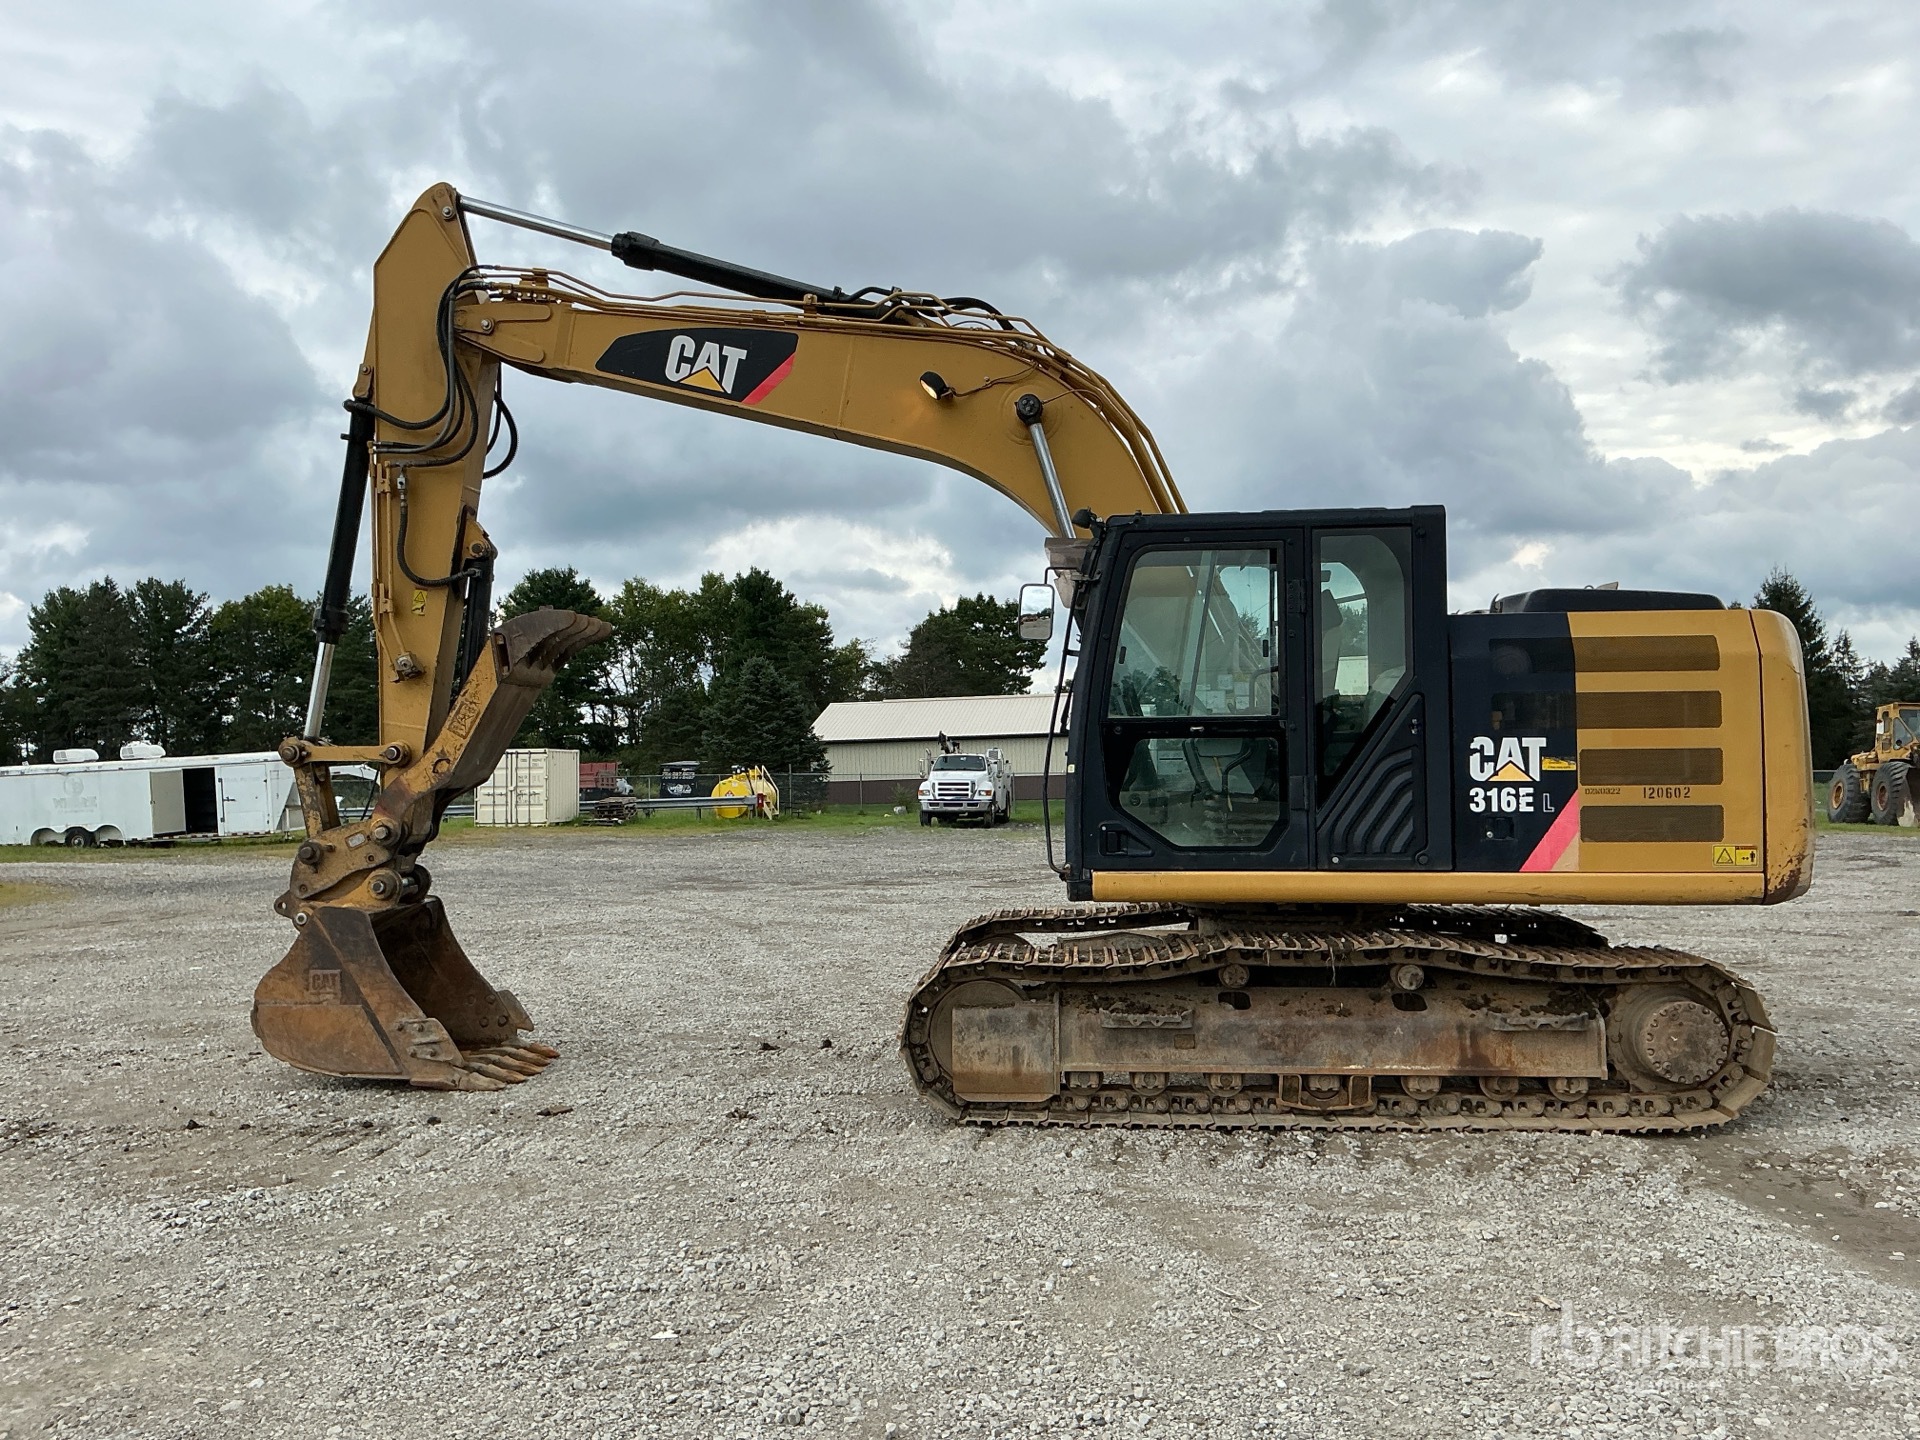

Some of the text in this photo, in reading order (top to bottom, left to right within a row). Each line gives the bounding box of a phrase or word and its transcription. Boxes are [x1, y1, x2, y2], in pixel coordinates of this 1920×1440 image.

[665, 334, 748, 394] CAT
[1469, 736, 1547, 782] CAT
[1469, 787, 1555, 812] 316E L
[1643, 786, 1691, 799] 120602
[311, 972, 338, 990] CAT
